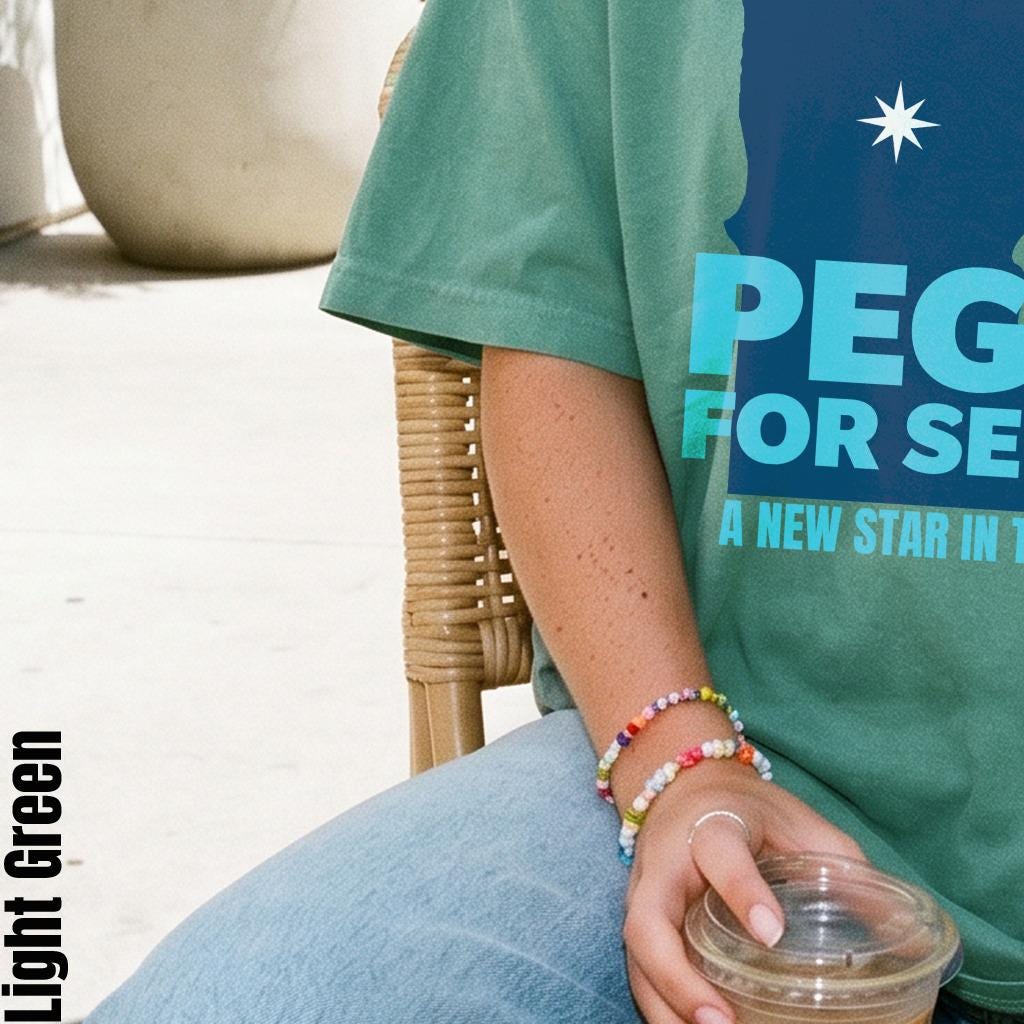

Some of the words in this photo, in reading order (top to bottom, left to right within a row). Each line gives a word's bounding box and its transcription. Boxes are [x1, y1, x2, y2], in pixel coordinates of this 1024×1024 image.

[681, 389, 879, 470] FOR
[718, 500, 743, 546] A
[757, 502, 841, 552] NEW
[854, 509, 948, 559] STAR
[961, 515, 998, 562] IN
